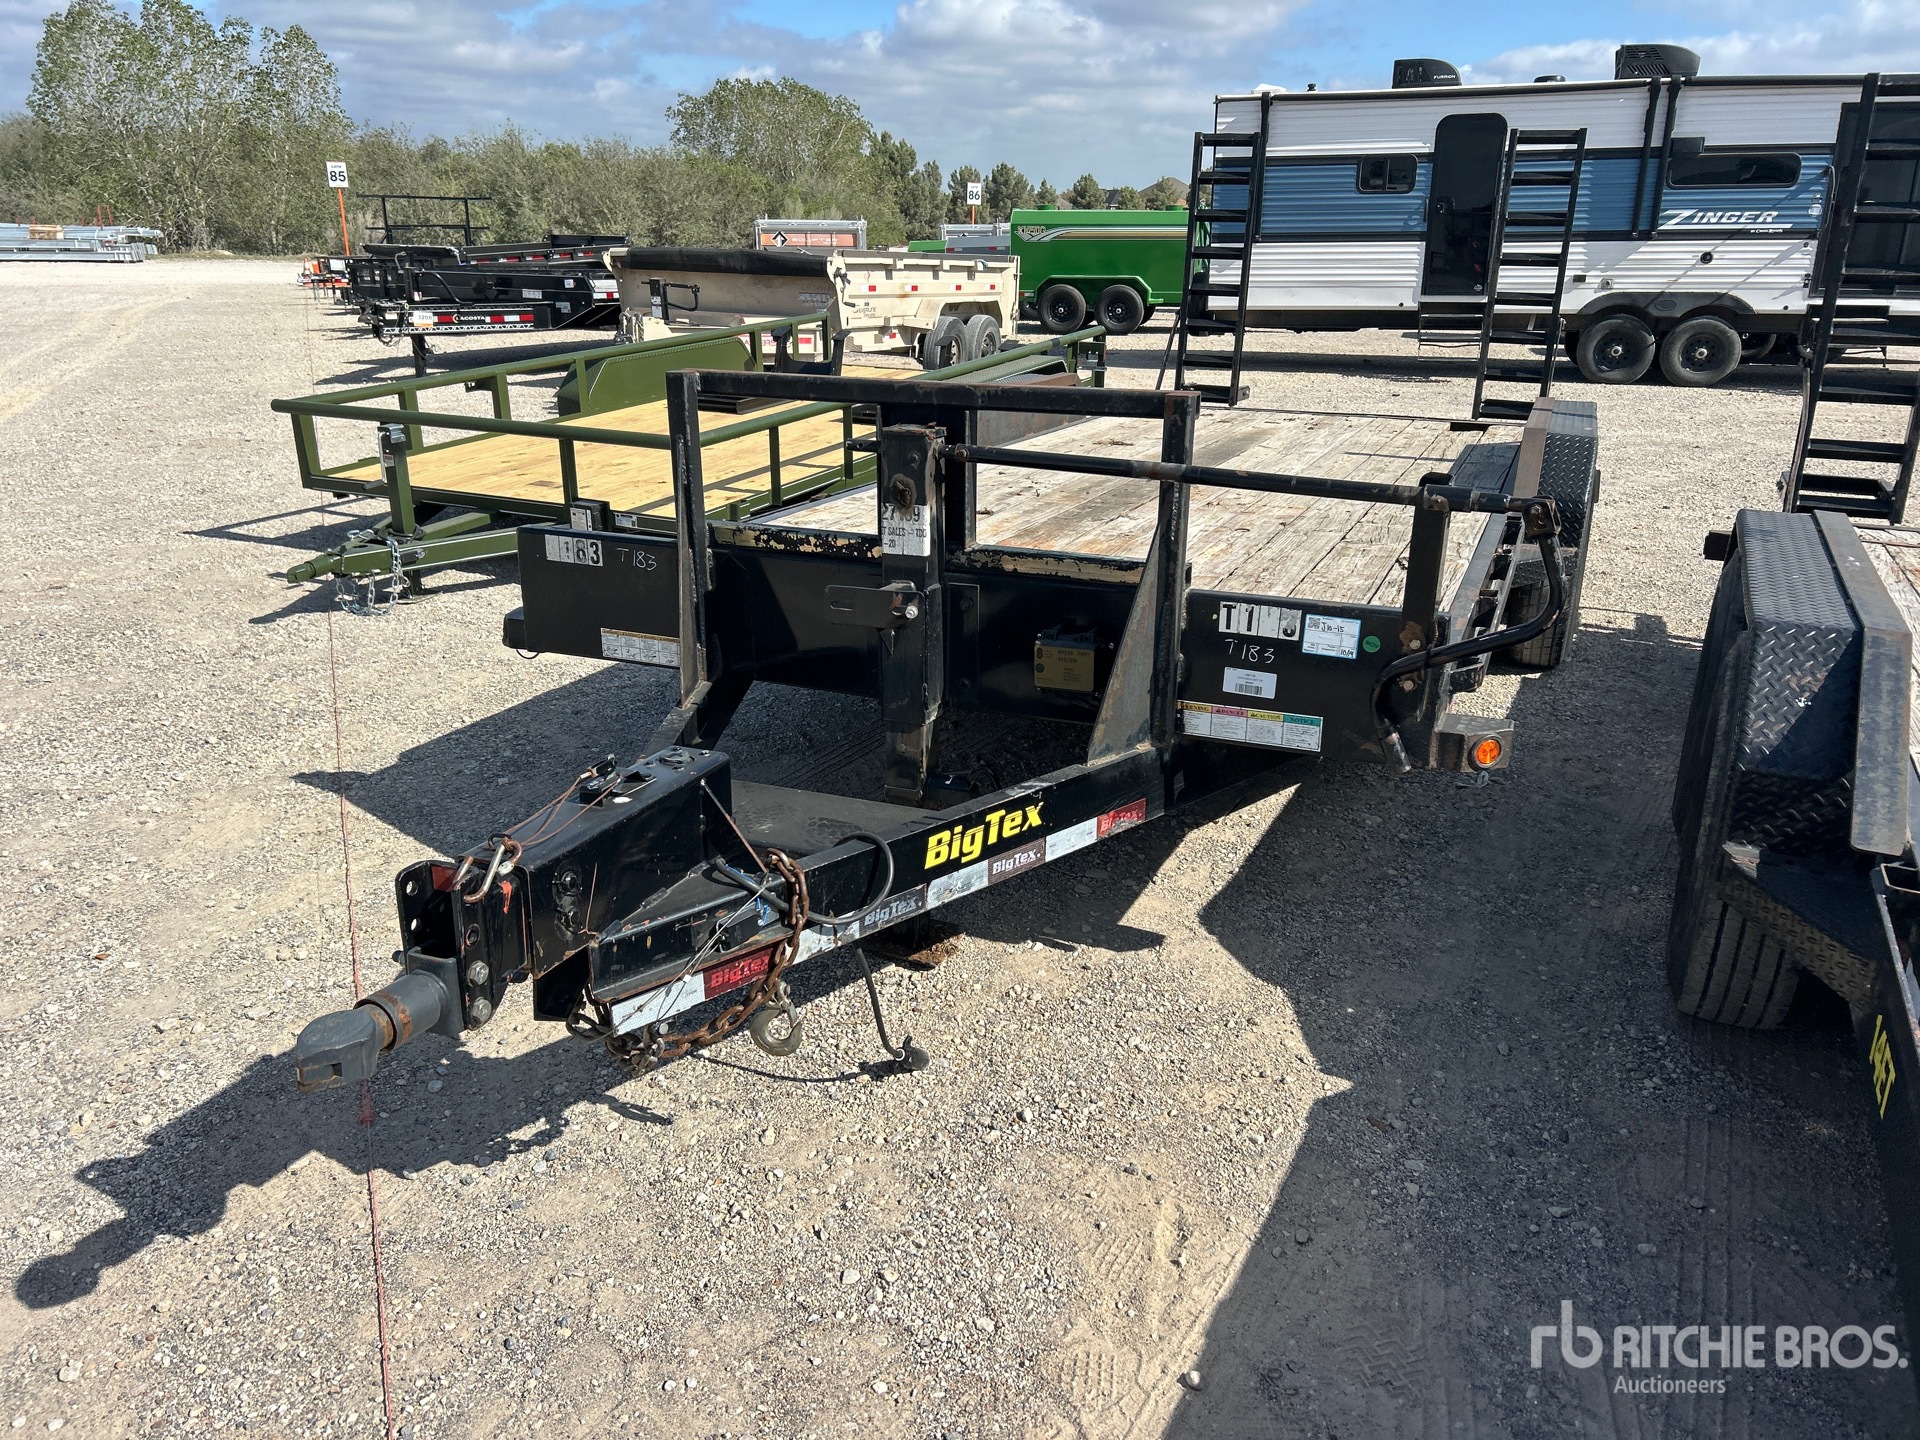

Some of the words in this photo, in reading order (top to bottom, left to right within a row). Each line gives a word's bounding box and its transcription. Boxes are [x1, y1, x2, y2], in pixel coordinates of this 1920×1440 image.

[329, 170, 347, 182] 85
[968, 190, 981, 200] 86
[1657, 208, 1779, 229] ZINGER
[887, 527, 906, 537] SALES
[1182, 702, 1210, 711] ARNING
[1255, 712, 1281, 720] CAUTION
[924, 801, 1045, 870] BigTex
[992, 848, 1037, 875] BigTex
